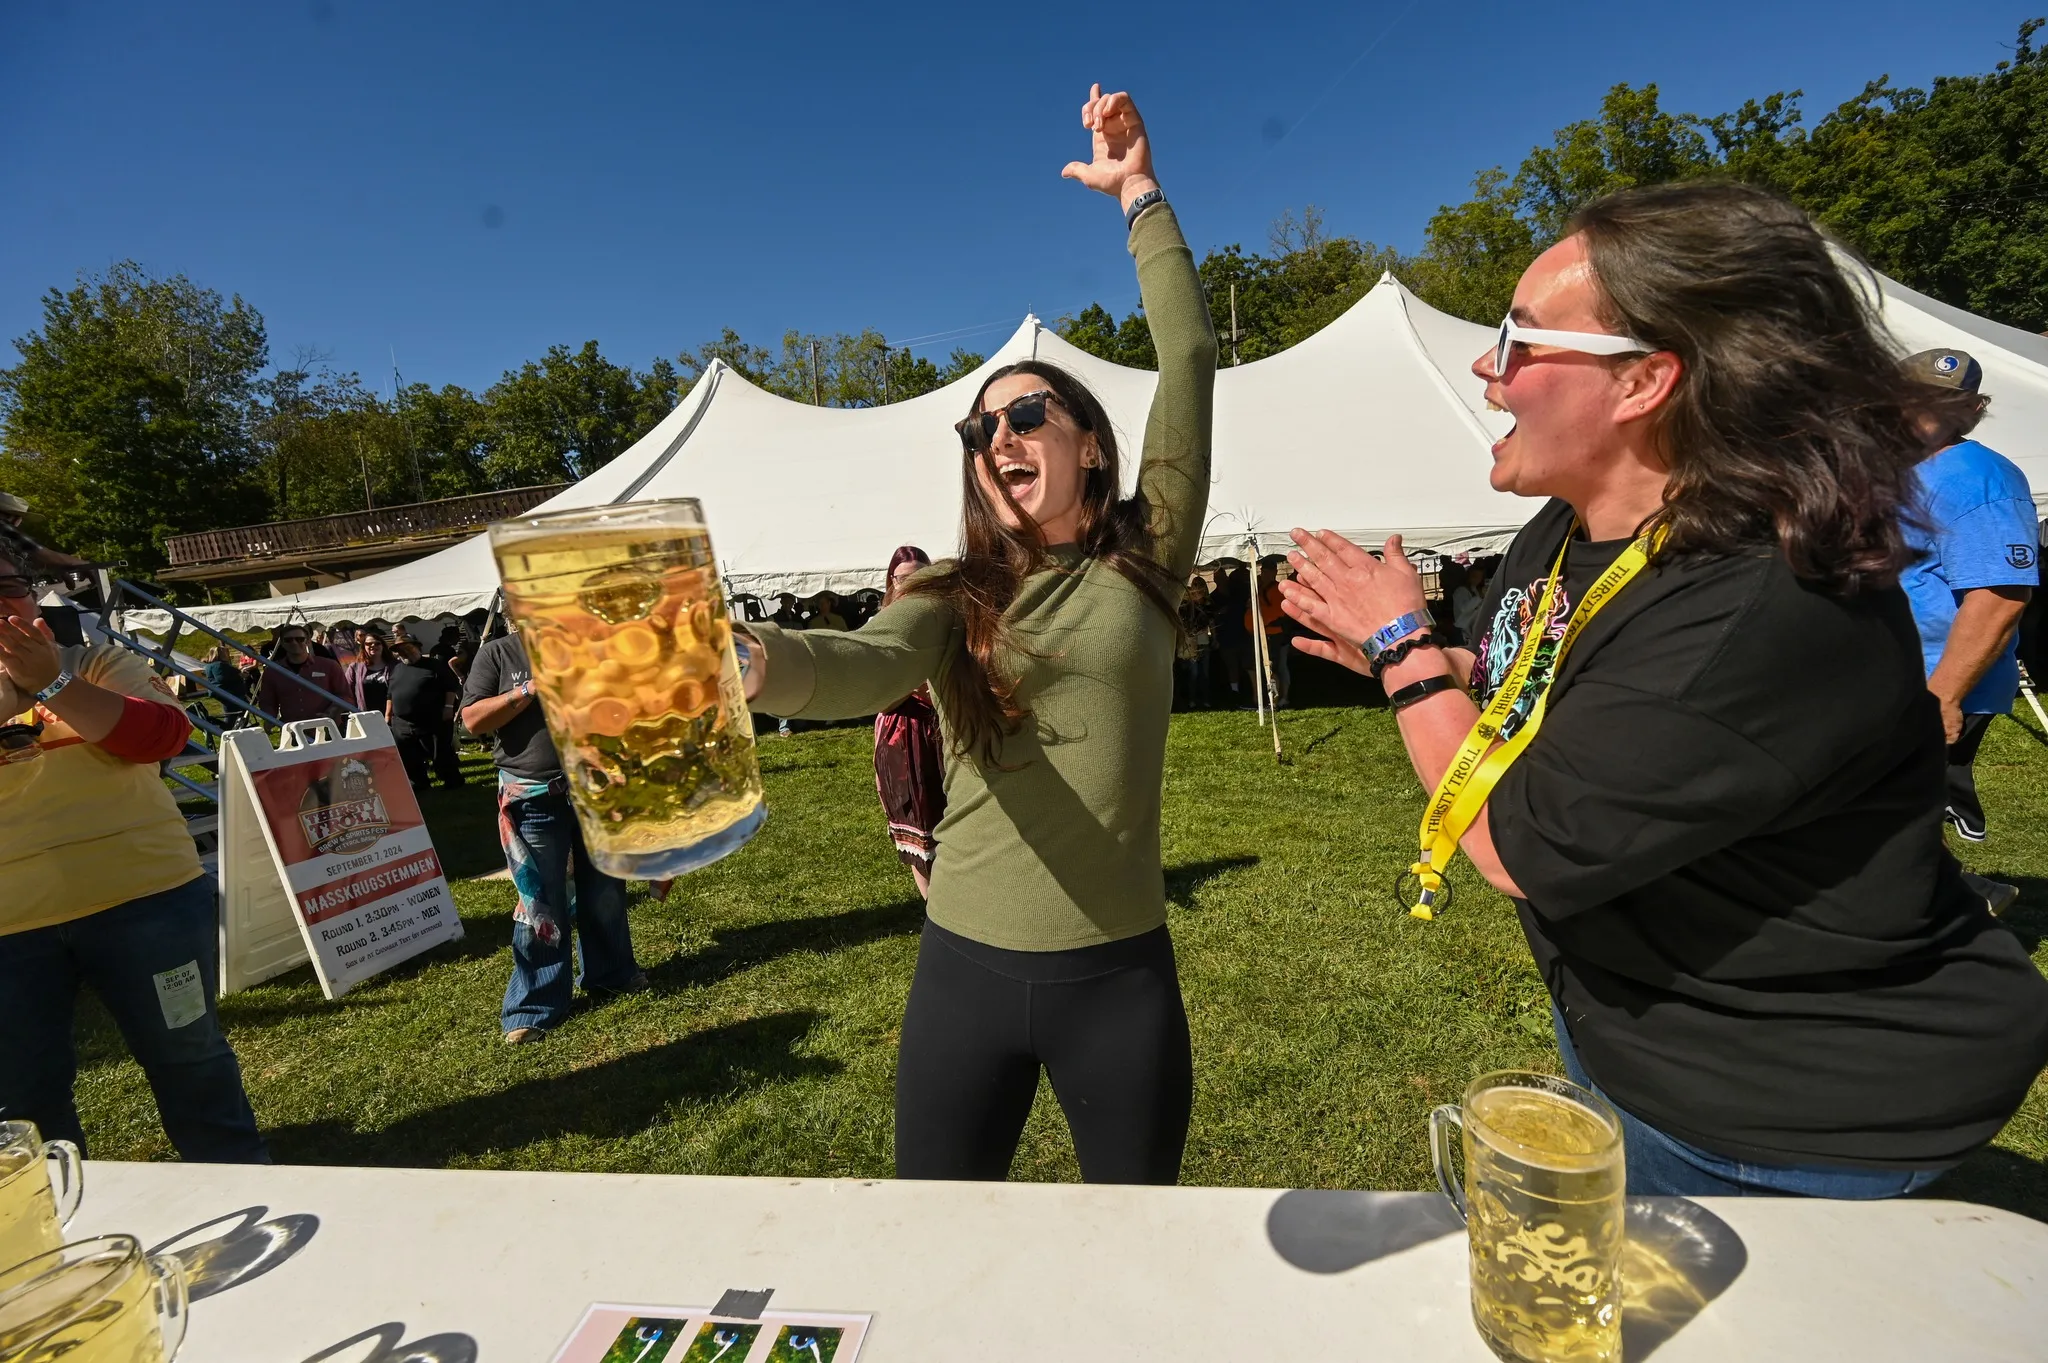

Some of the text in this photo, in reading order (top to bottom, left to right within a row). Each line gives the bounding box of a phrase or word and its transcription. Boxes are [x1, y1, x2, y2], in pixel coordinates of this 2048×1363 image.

[1560, 565, 1630, 656] THIRSTY TROLL
[1375, 624, 1400, 644] VIP
[1490, 632, 1540, 717] THIRSTY TROLL
[1427, 748, 1481, 834] THIRSTY TROLL
[304, 797, 378, 824] THIRSTY
[309, 809, 384, 839] TROLL
[318, 837, 340, 853] BREW
[345, 829, 371, 840] SPIRITS
[371, 827, 388, 835] FEST
[326, 845, 403, 877] SEPTEMBER 7, 2024
[304, 857, 435, 915] MASSKRUGSTEMMEN
[321, 922, 354, 942] ROUND
[406, 886, 441, 907] WOMEN
[336, 937, 368, 957] ROUND
[421, 904, 441, 921] MEN
[165, 974, 180, 984] SEP
[185, 974, 196, 984] AM
